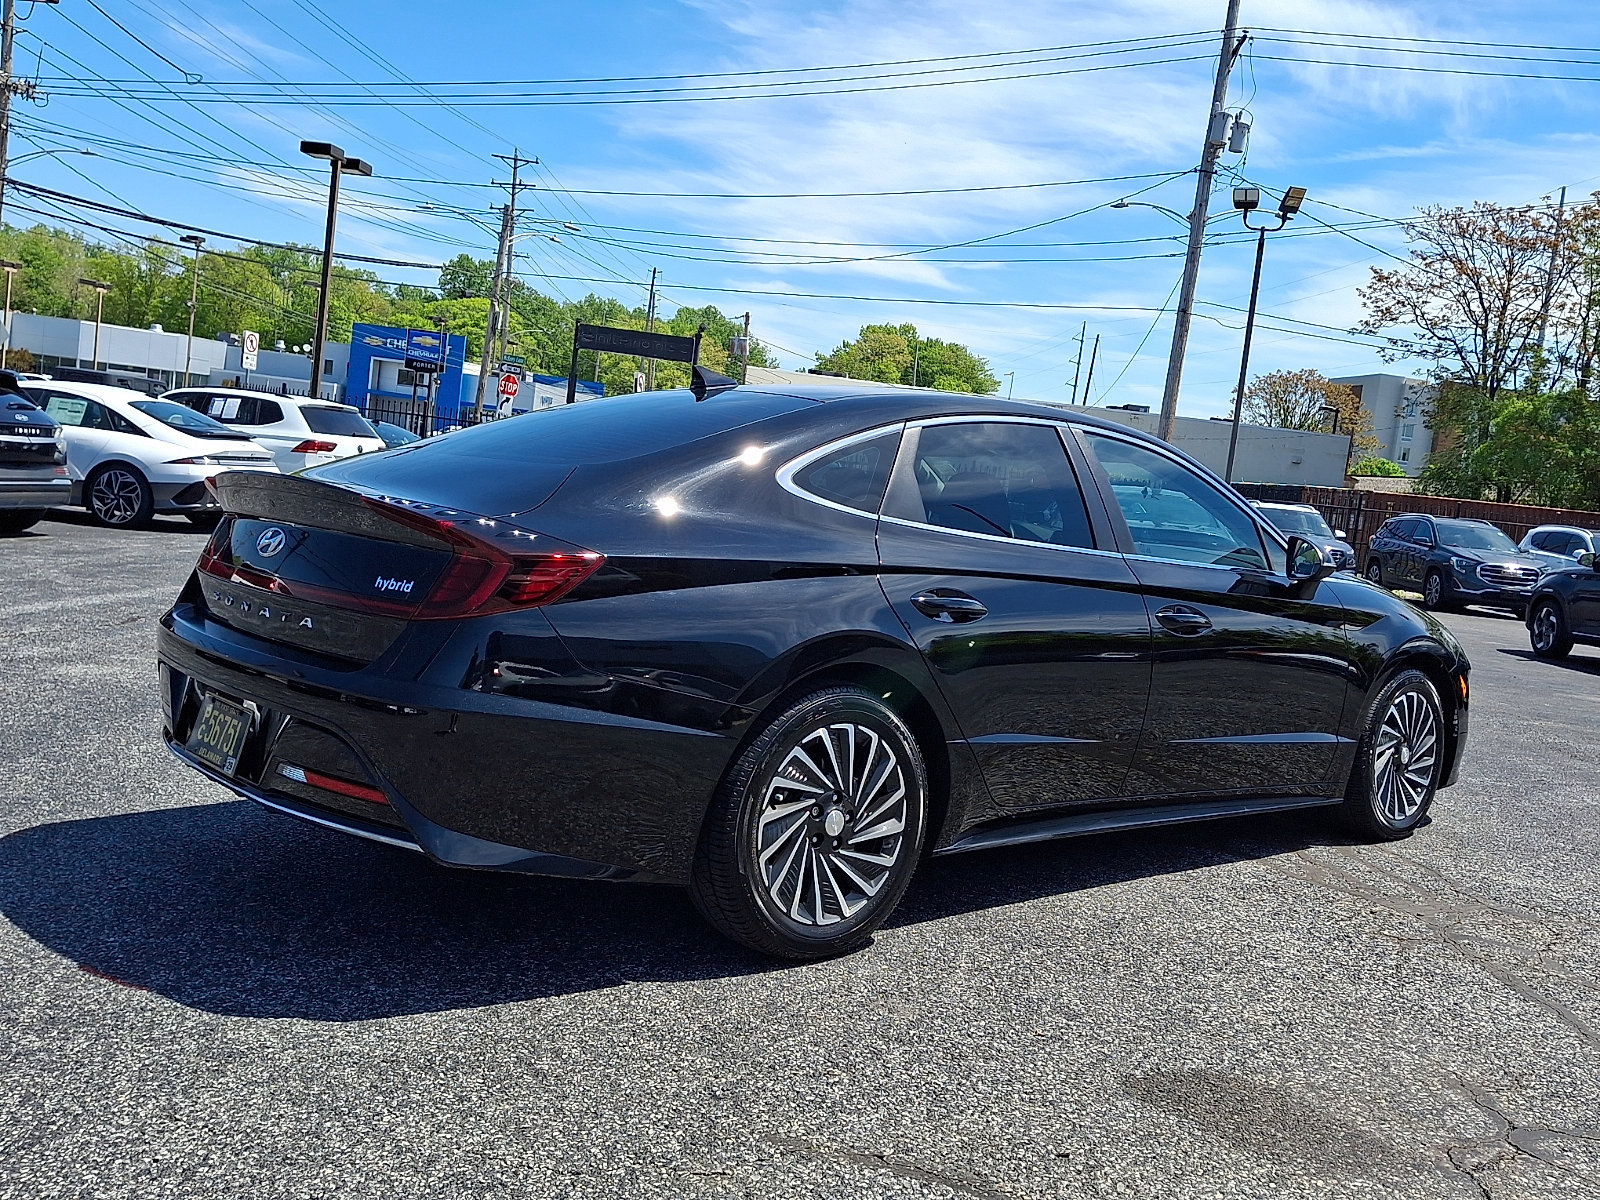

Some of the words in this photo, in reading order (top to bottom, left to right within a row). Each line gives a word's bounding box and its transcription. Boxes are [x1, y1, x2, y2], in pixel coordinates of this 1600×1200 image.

[413, 361, 436, 370] PORTER
[499, 380, 518, 393] STOP
[374, 576, 415, 594] hybrid
[212, 591, 314, 630] SONATA
